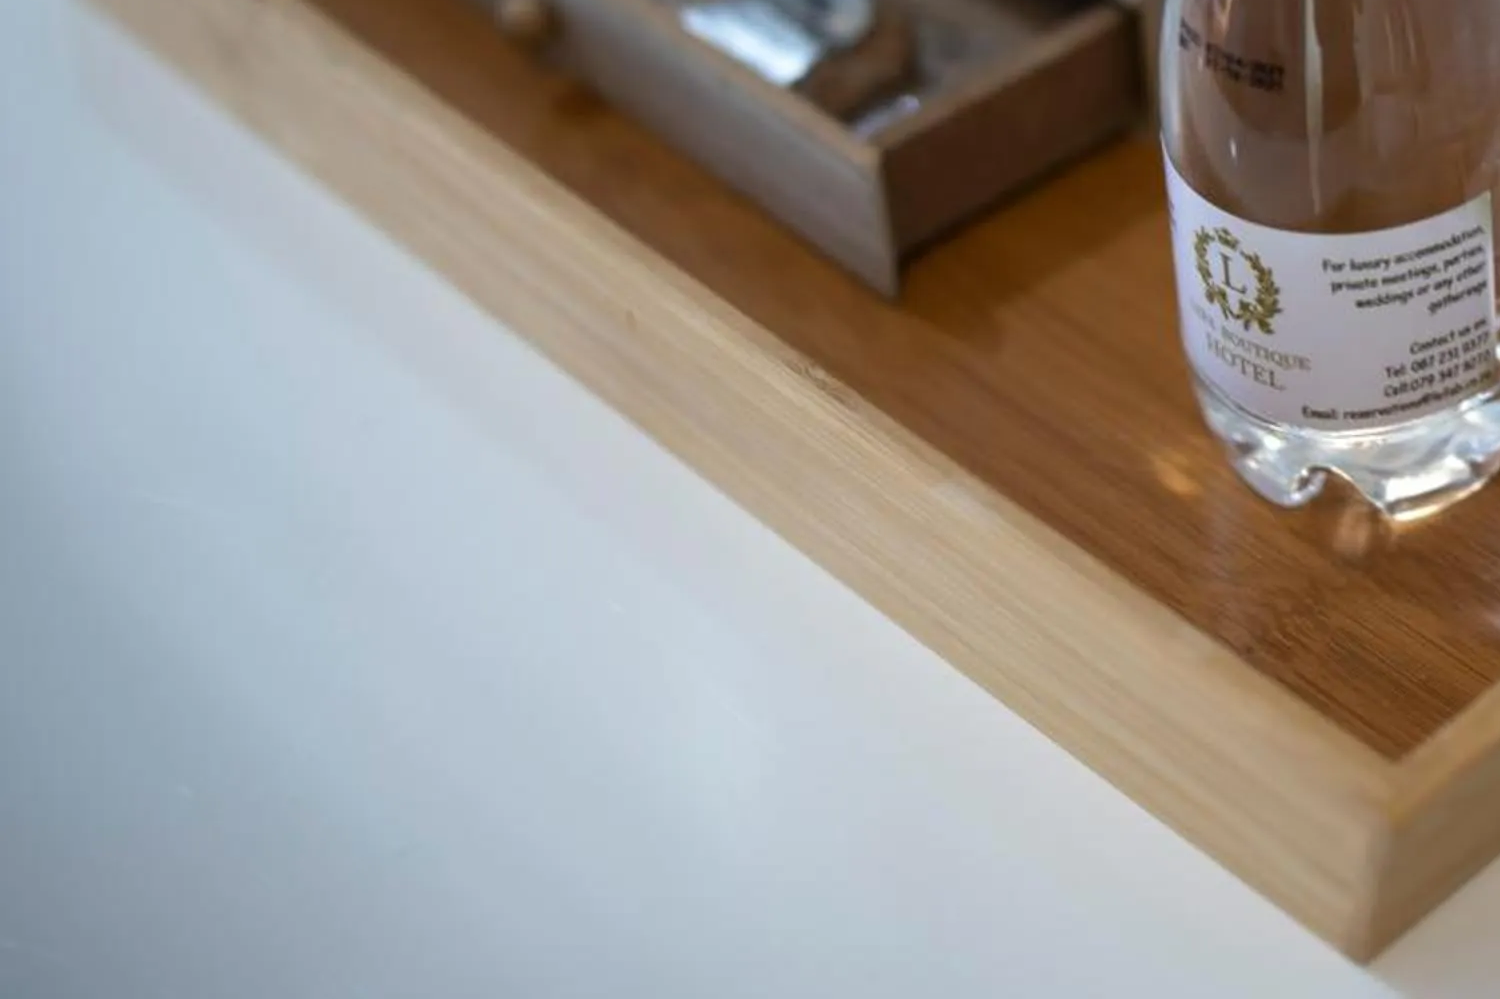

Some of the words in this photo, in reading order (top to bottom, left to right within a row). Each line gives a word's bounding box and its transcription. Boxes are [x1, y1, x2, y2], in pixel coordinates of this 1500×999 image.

[1220, 252, 1247, 294] L
[1322, 258, 1345, 272] For
[1350, 257, 1390, 272] luxury
[1355, 289, 1414, 308] weddings
[1416, 283, 1430, 297] or
[1433, 278, 1453, 295] any
[1456, 261, 1486, 282] other
[1331, 278, 1378, 296] private
[1221, 325, 1312, 371] BOUTIQUE
[1409, 329, 1455, 355] Contact
[1457, 325, 1471, 337] us
[1206, 333, 1287, 391] HOTEL
